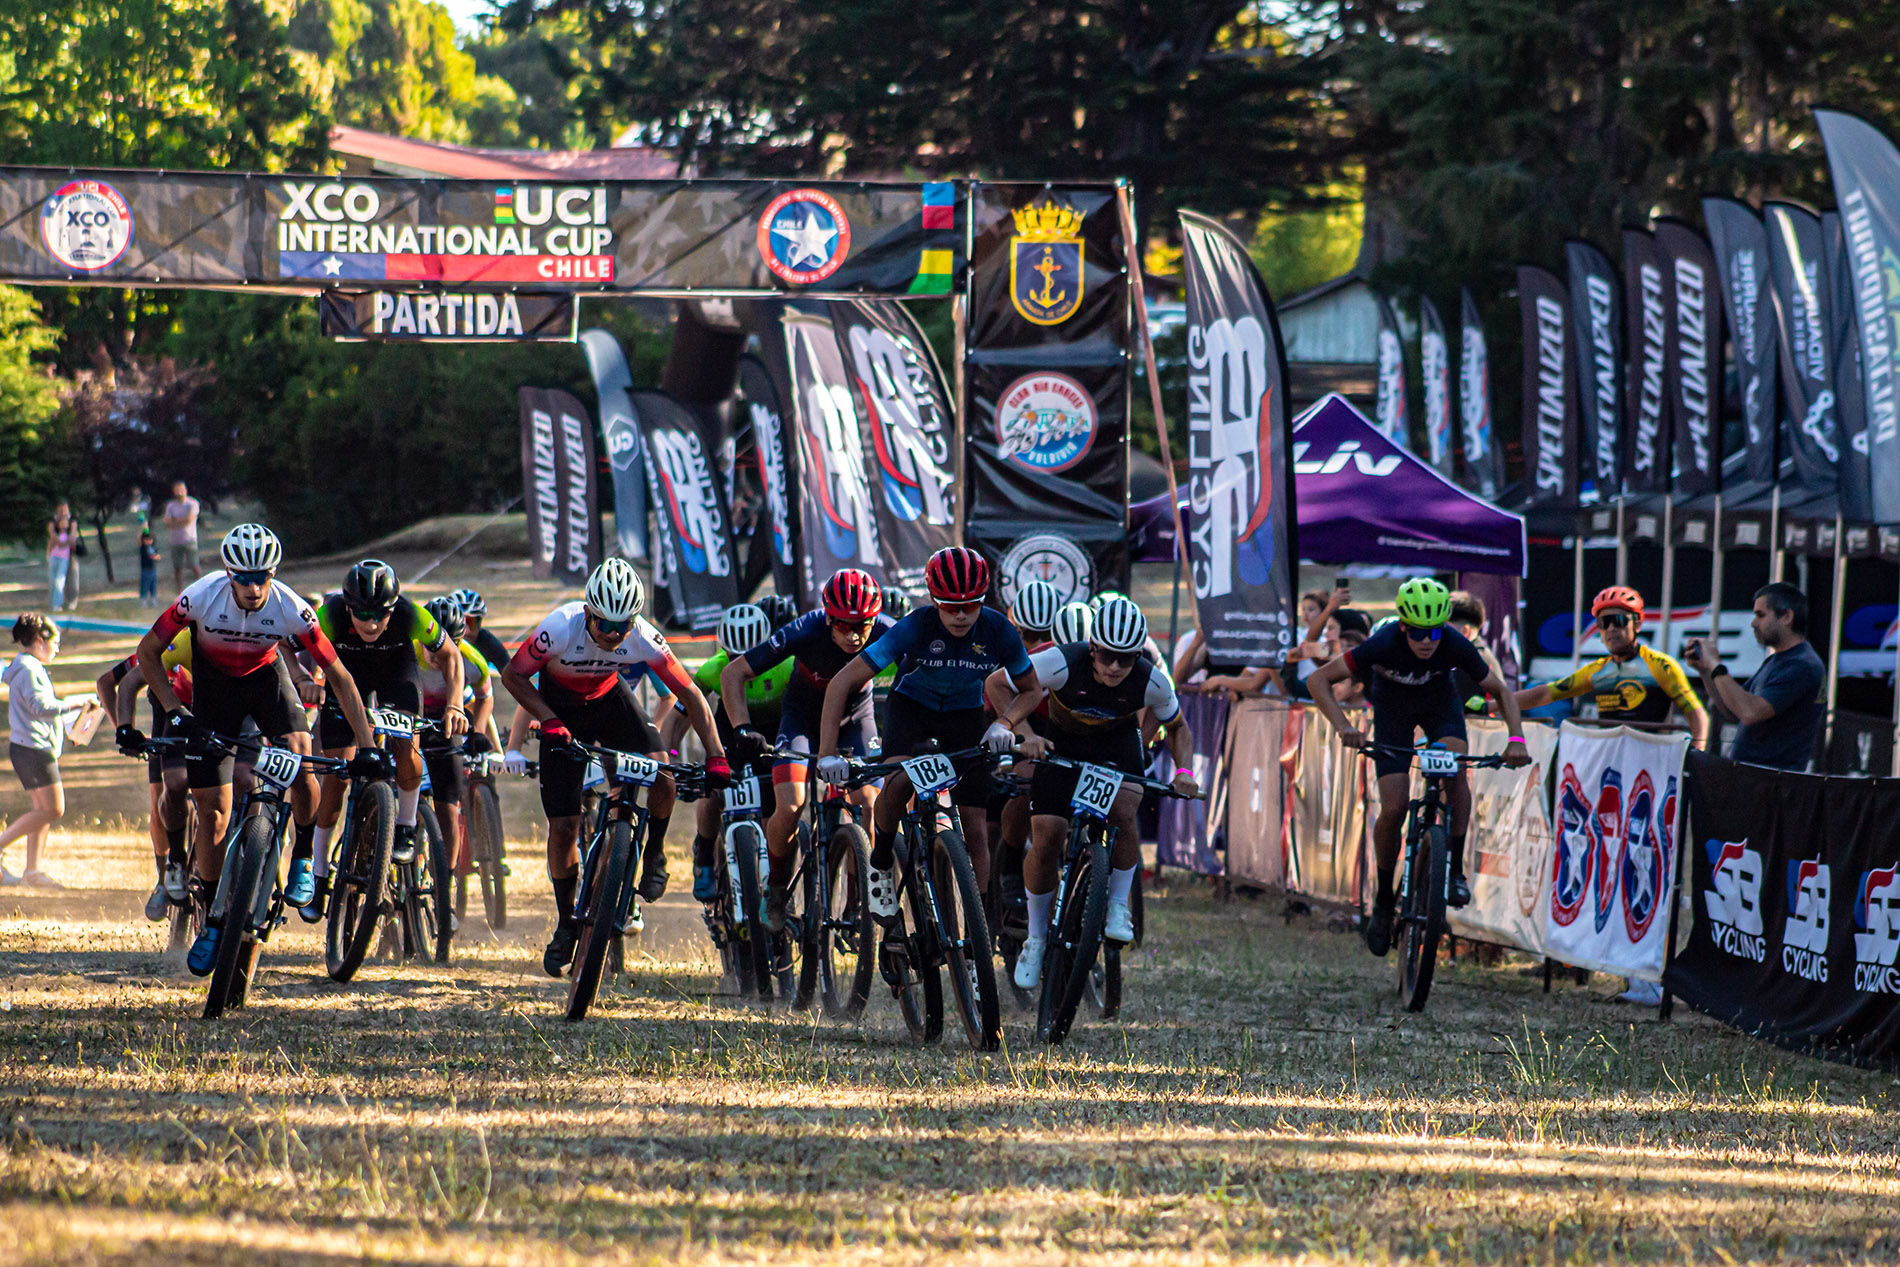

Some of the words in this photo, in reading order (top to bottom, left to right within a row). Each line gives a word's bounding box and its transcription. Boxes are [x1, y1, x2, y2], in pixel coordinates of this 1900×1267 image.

[66, 210, 110, 228] XCO
[280, 181, 380, 222] XCO
[515, 188, 607, 226] UCI
[278, 222, 540, 256] INTERNATIONAL
[545, 225, 614, 256] CUP
[537, 257, 612, 280] CHILE
[374, 293, 524, 336] PARTIDA
[1586, 274, 1616, 484] SPECIALIZED
[1634, 263, 1663, 472] SPECIALIZED
[1674, 257, 1709, 474] SPECIALIZED
[1536, 295, 1565, 496] SPECIALIZED
[532, 408, 560, 564] SPECIALIZED
[560, 413, 590, 575] SPECIALIZED
[685, 430, 731, 577] CYCLING
[378, 712, 409, 729] 164
[262, 753, 296, 782] 190
[910, 758, 949, 787] 184
[731, 780, 754, 807] 161
[1078, 774, 1115, 809] 258
[1710, 921, 1766, 963] YCLING
